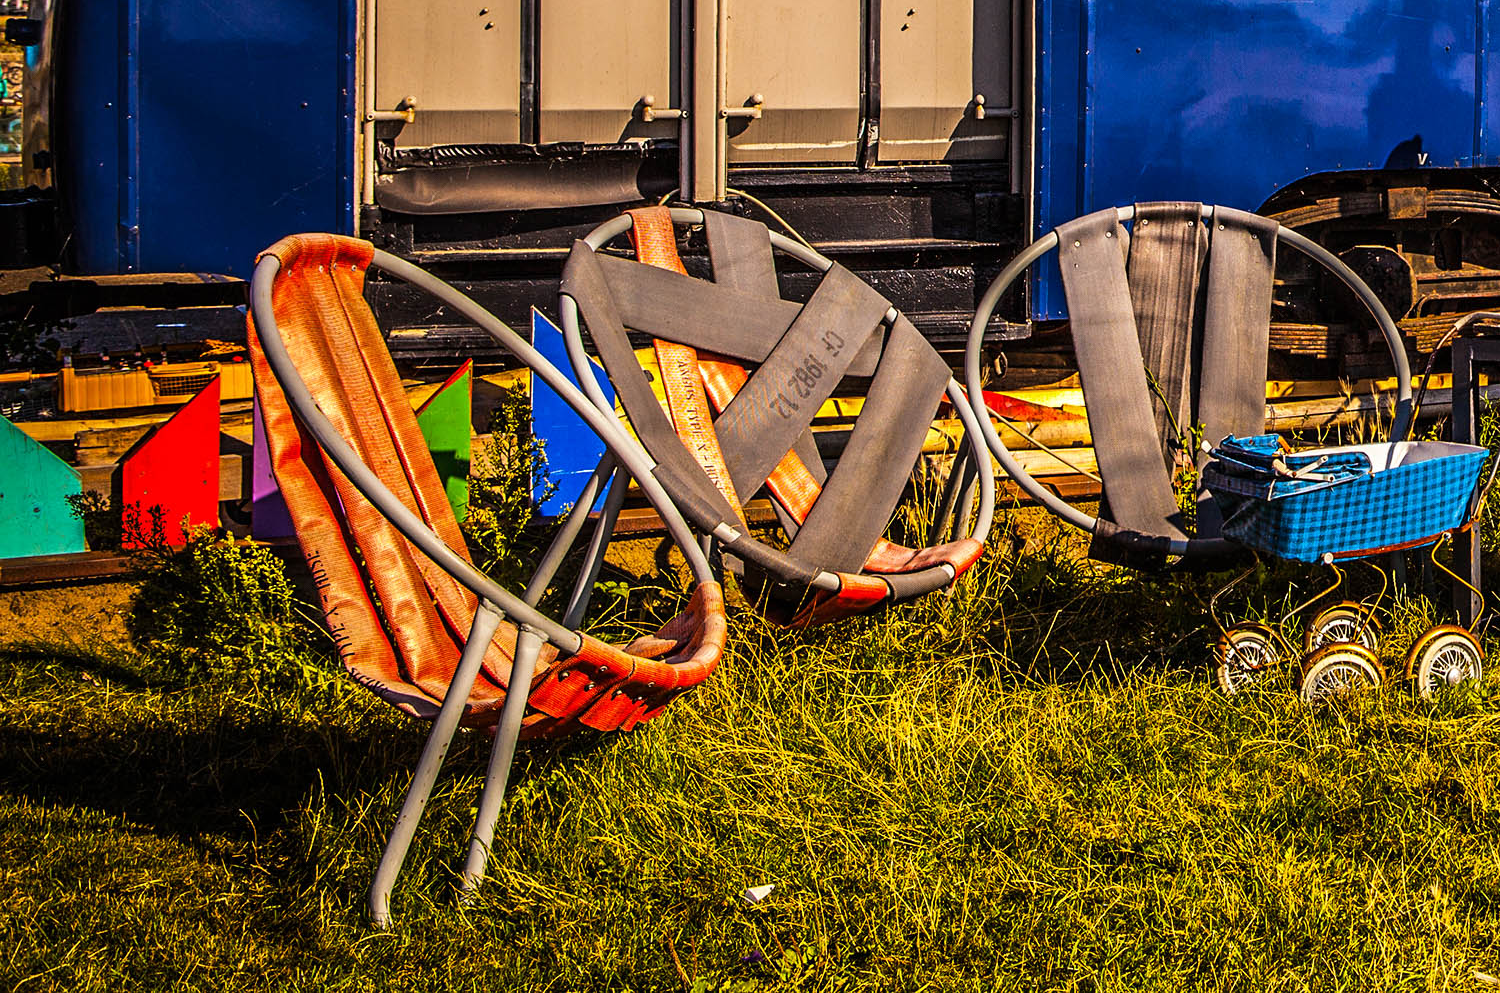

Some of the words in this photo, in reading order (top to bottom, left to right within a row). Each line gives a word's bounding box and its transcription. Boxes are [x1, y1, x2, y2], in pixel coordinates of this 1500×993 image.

[821, 330, 845, 357] CF
[787, 353, 828, 399] 1982
[677, 359, 696, 401] ANGUS
[687, 407, 705, 436] TYPE
[769, 393, 799, 420] 12
[307, 550, 331, 590] HOSE
